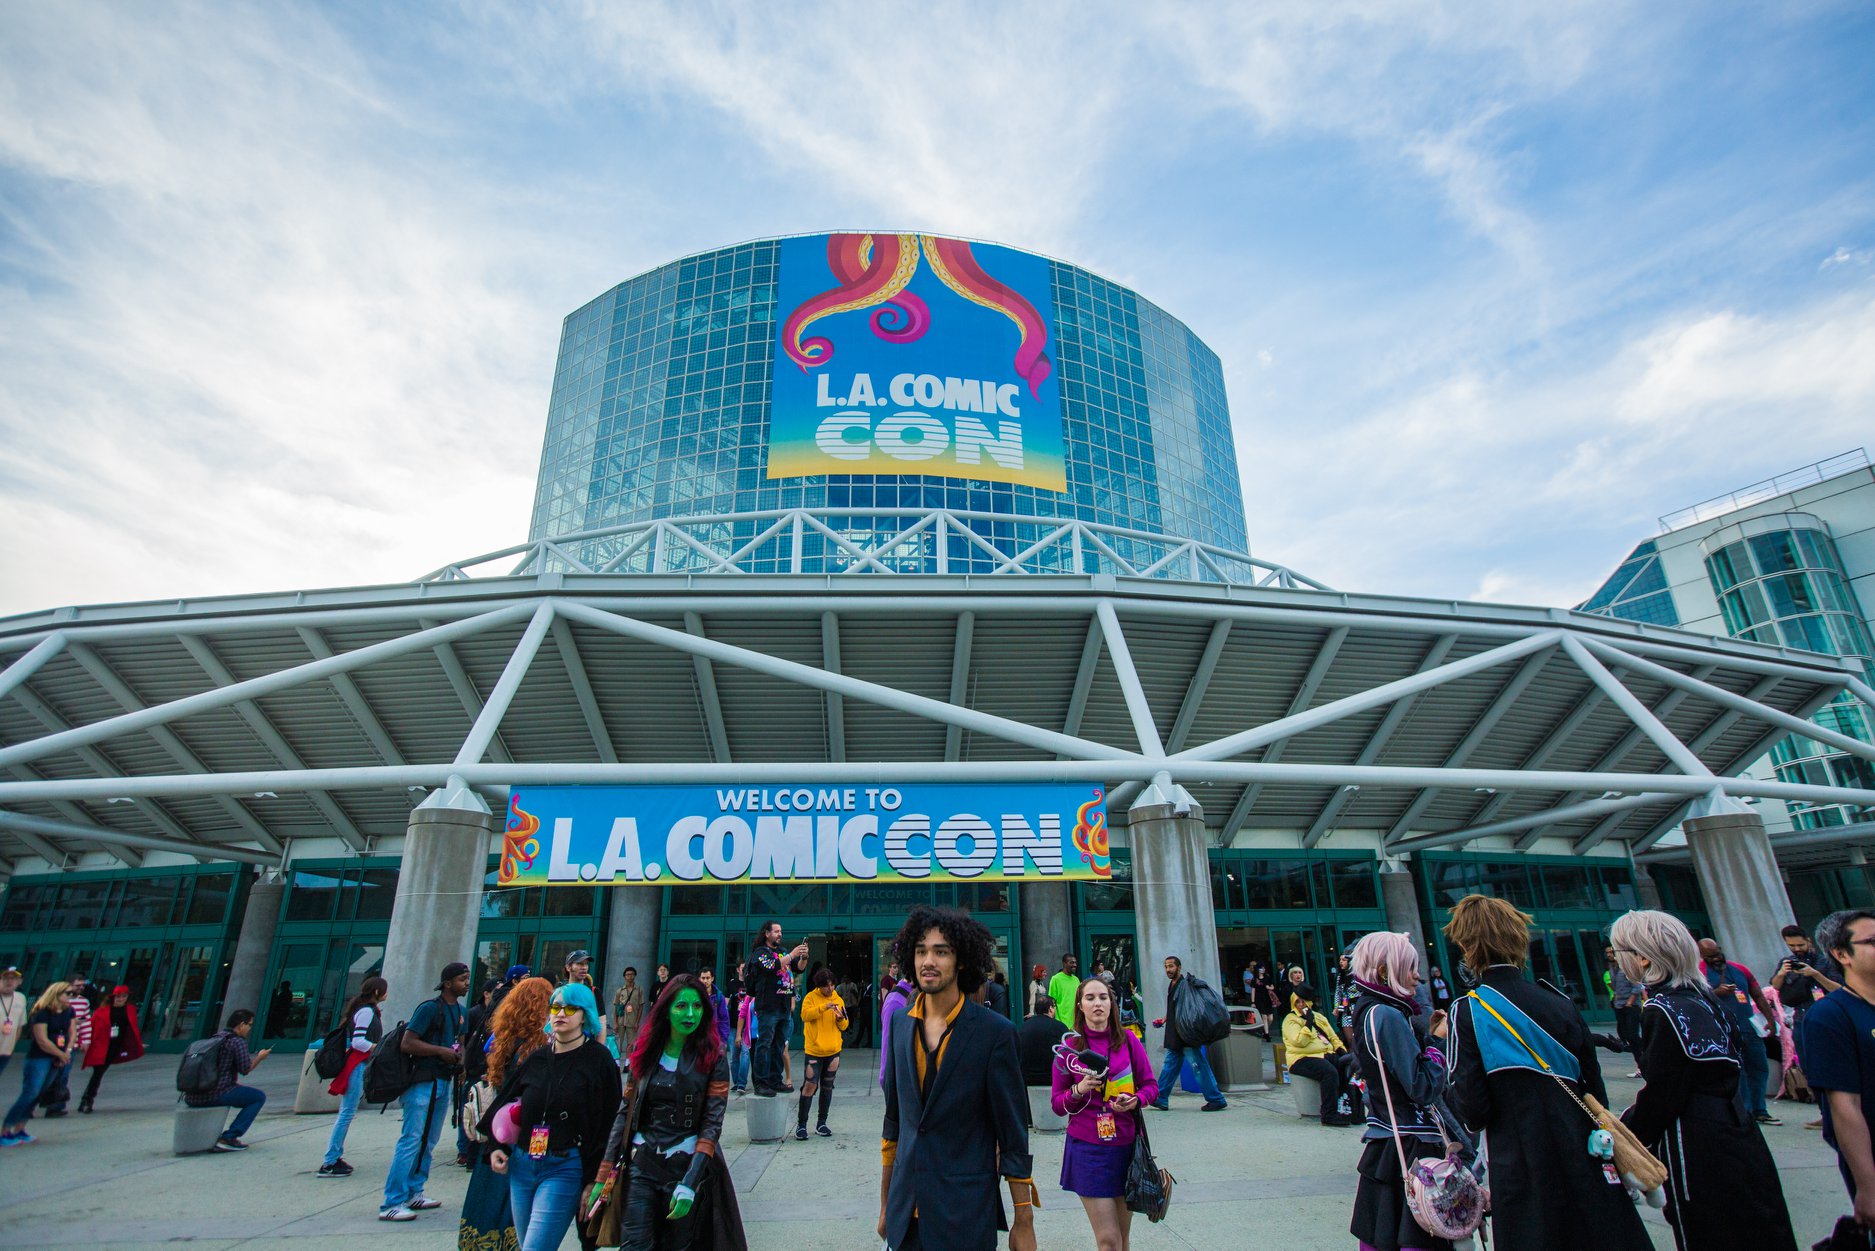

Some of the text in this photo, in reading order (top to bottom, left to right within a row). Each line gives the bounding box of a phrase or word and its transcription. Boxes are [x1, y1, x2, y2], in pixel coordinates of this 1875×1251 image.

[816, 373, 1021, 418] L.A. COMIC
[814, 410, 1025, 470] CON
[716, 788, 903, 811] WELCOME TO
[547, 813, 1064, 883] L.A. COMIC CON
[854, 889, 931, 899] WELCOME TO
